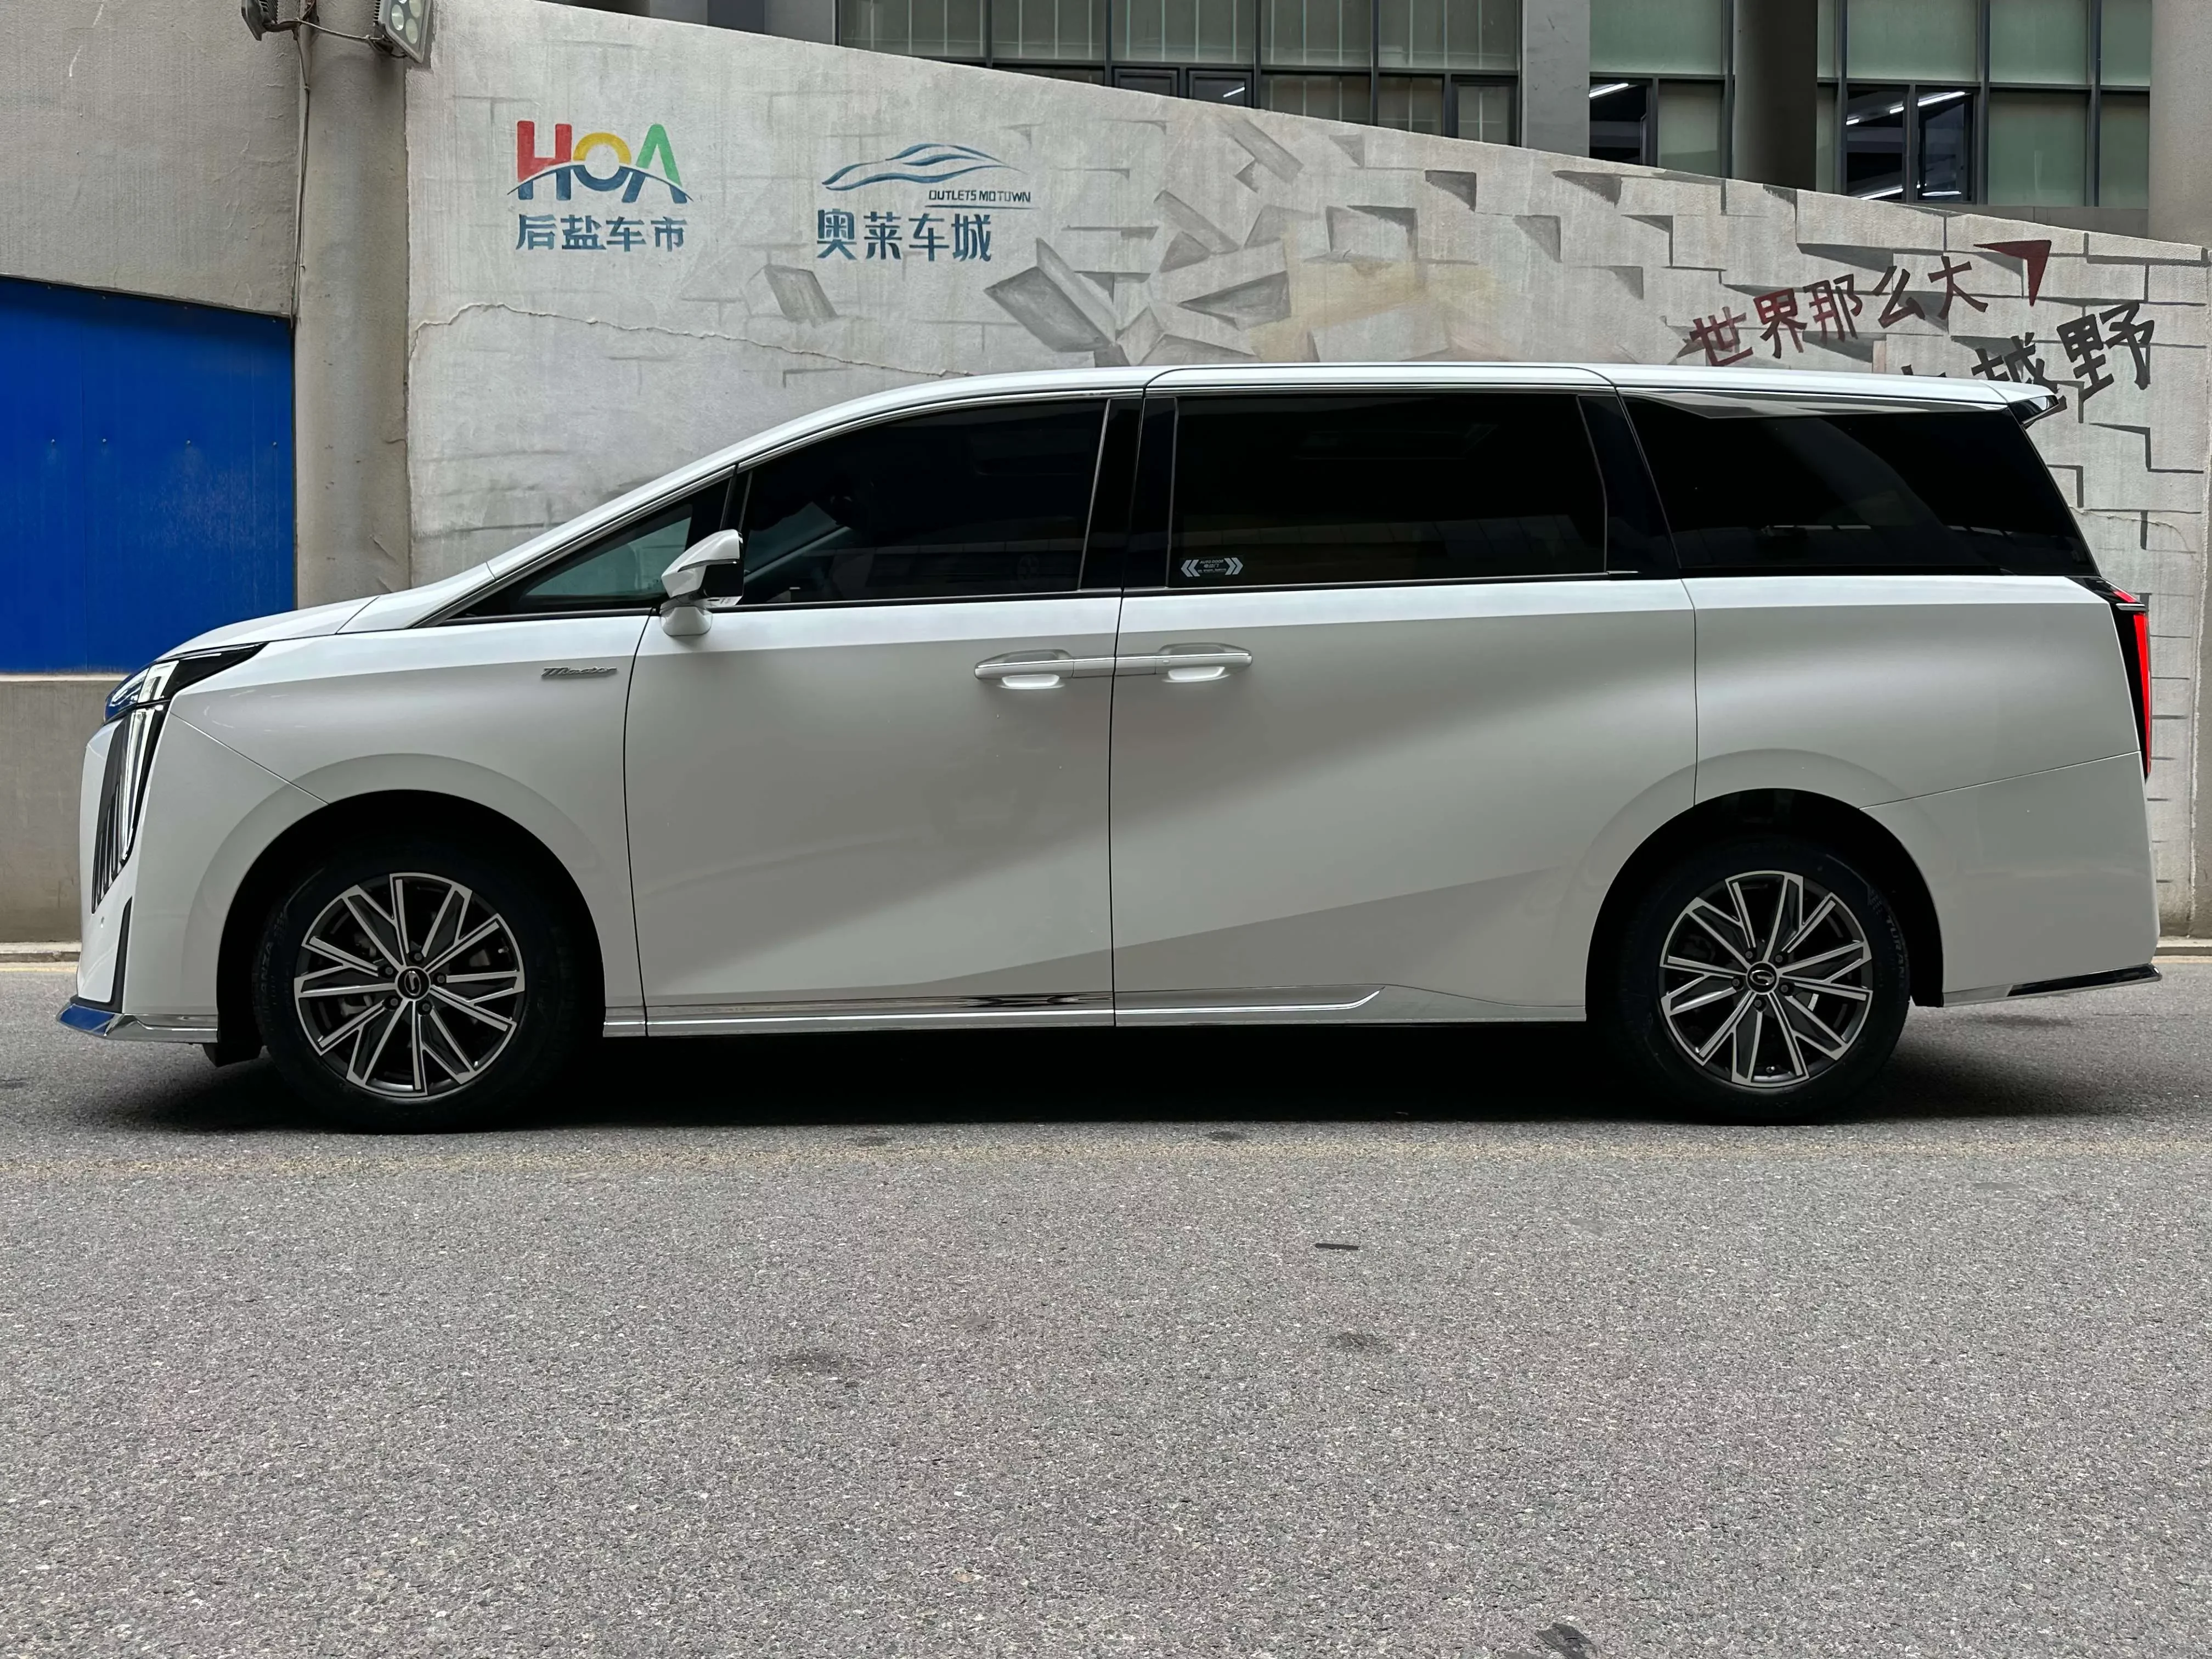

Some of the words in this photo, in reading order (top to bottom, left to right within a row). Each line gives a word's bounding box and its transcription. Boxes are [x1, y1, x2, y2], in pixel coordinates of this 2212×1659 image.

[517, 120, 688, 204] HOA
[928, 189, 977, 201] OUTLETS
[979, 190, 1031, 202] MOTOWN
[515, 213, 689, 252] 后盐车市
[816, 208, 992, 262] 奥莱车城
[1690, 255, 1988, 368] 世界那么大
